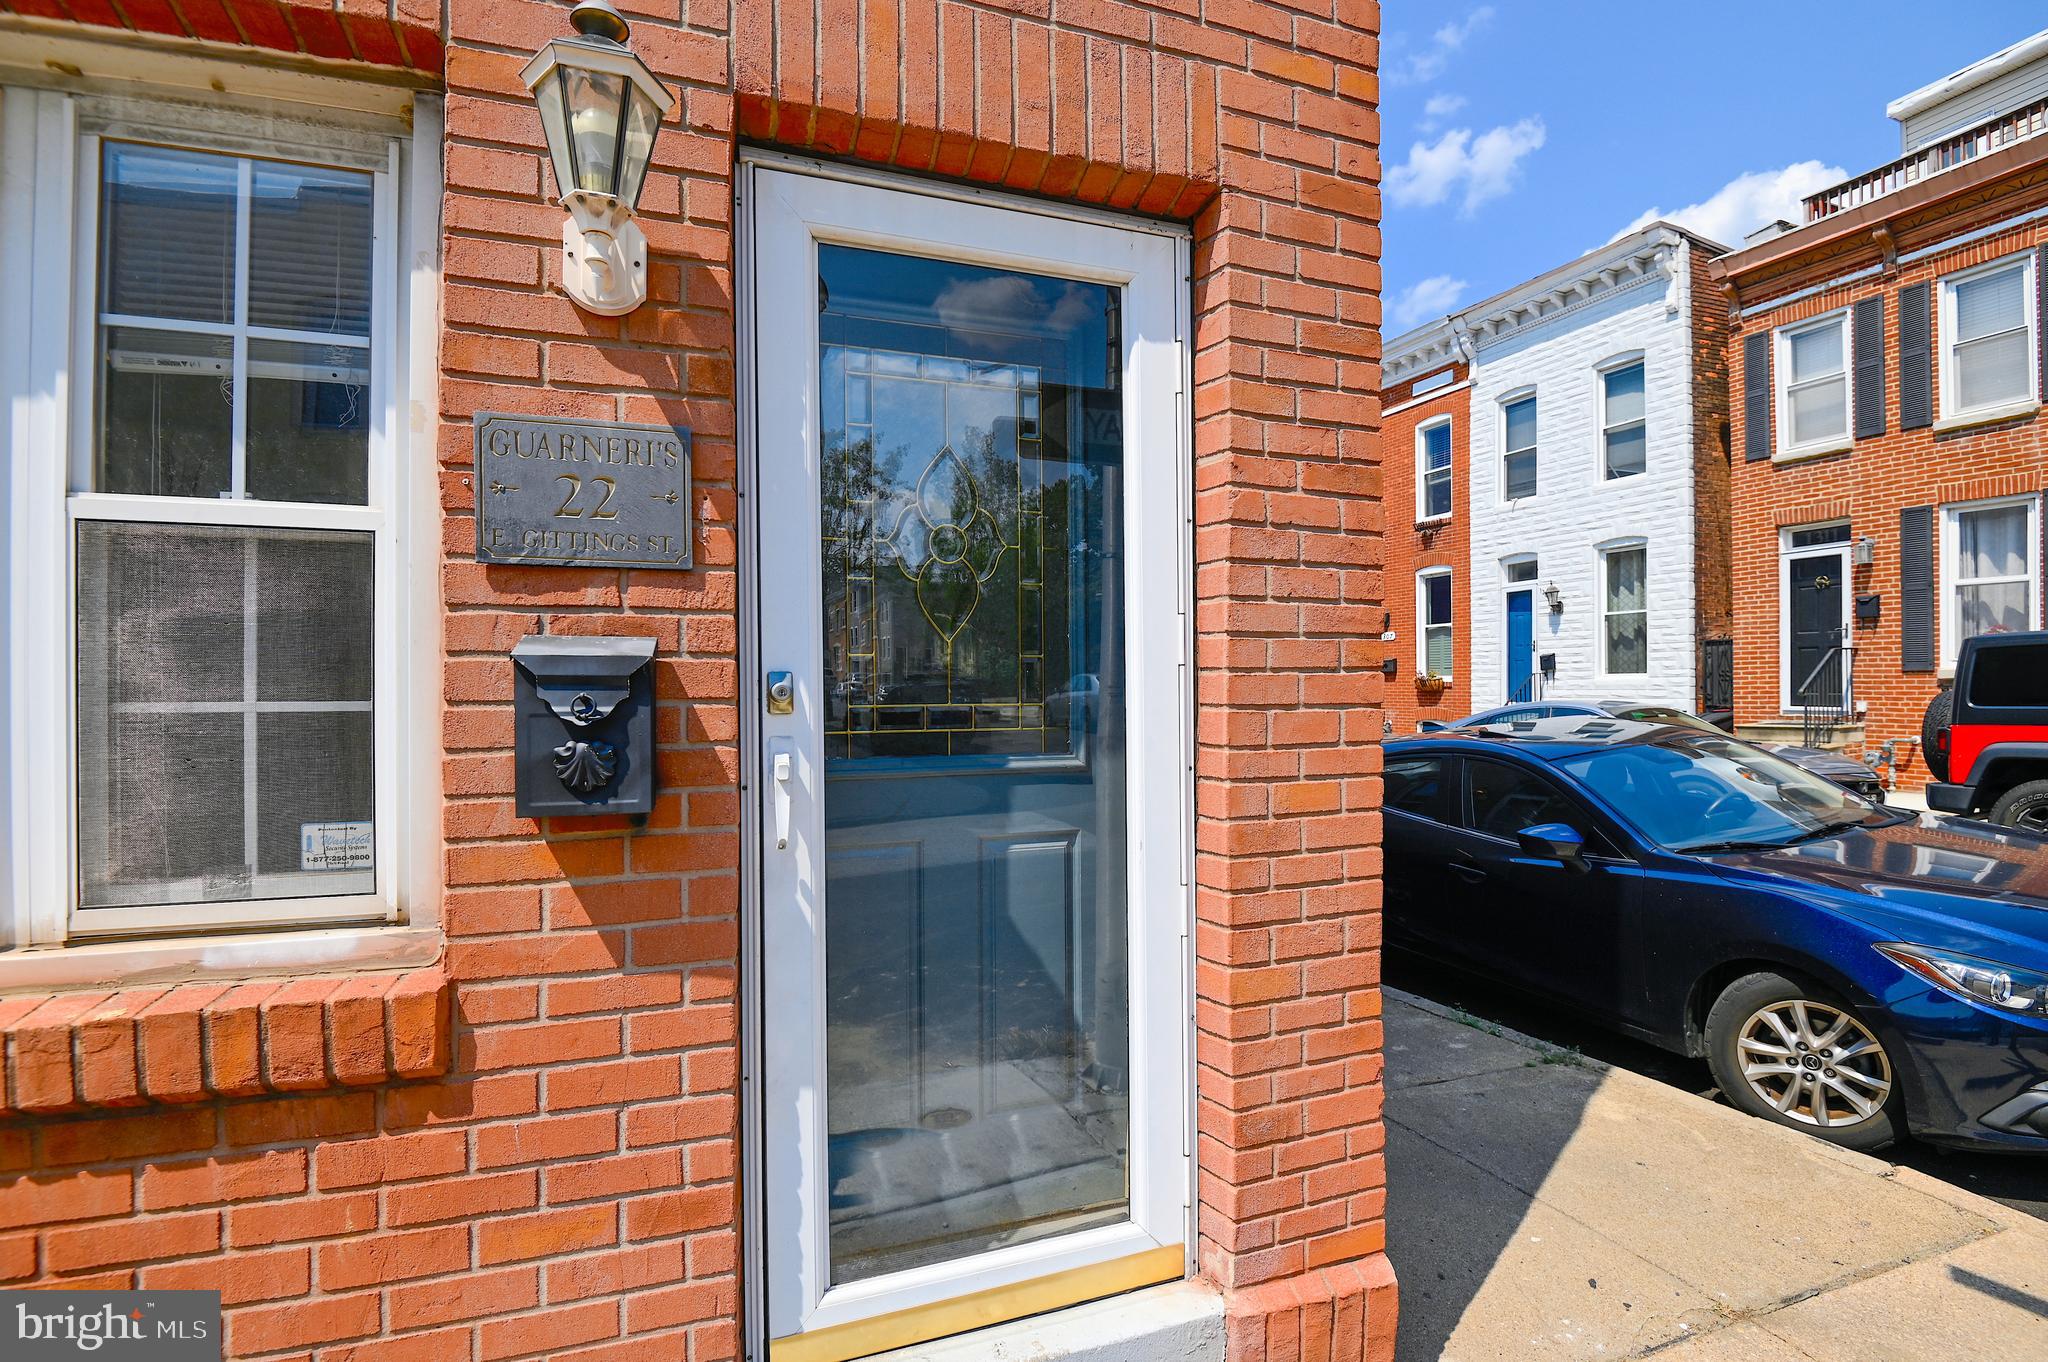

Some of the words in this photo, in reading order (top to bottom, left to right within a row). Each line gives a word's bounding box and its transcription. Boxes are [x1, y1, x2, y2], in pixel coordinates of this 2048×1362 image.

[489, 428, 679, 469] GUARNERI'S
[554, 473, 620, 521] 22
[492, 528, 513, 547] E.
[522, 528, 639, 552] GITTINGS
[647, 535, 680, 554] ST.
